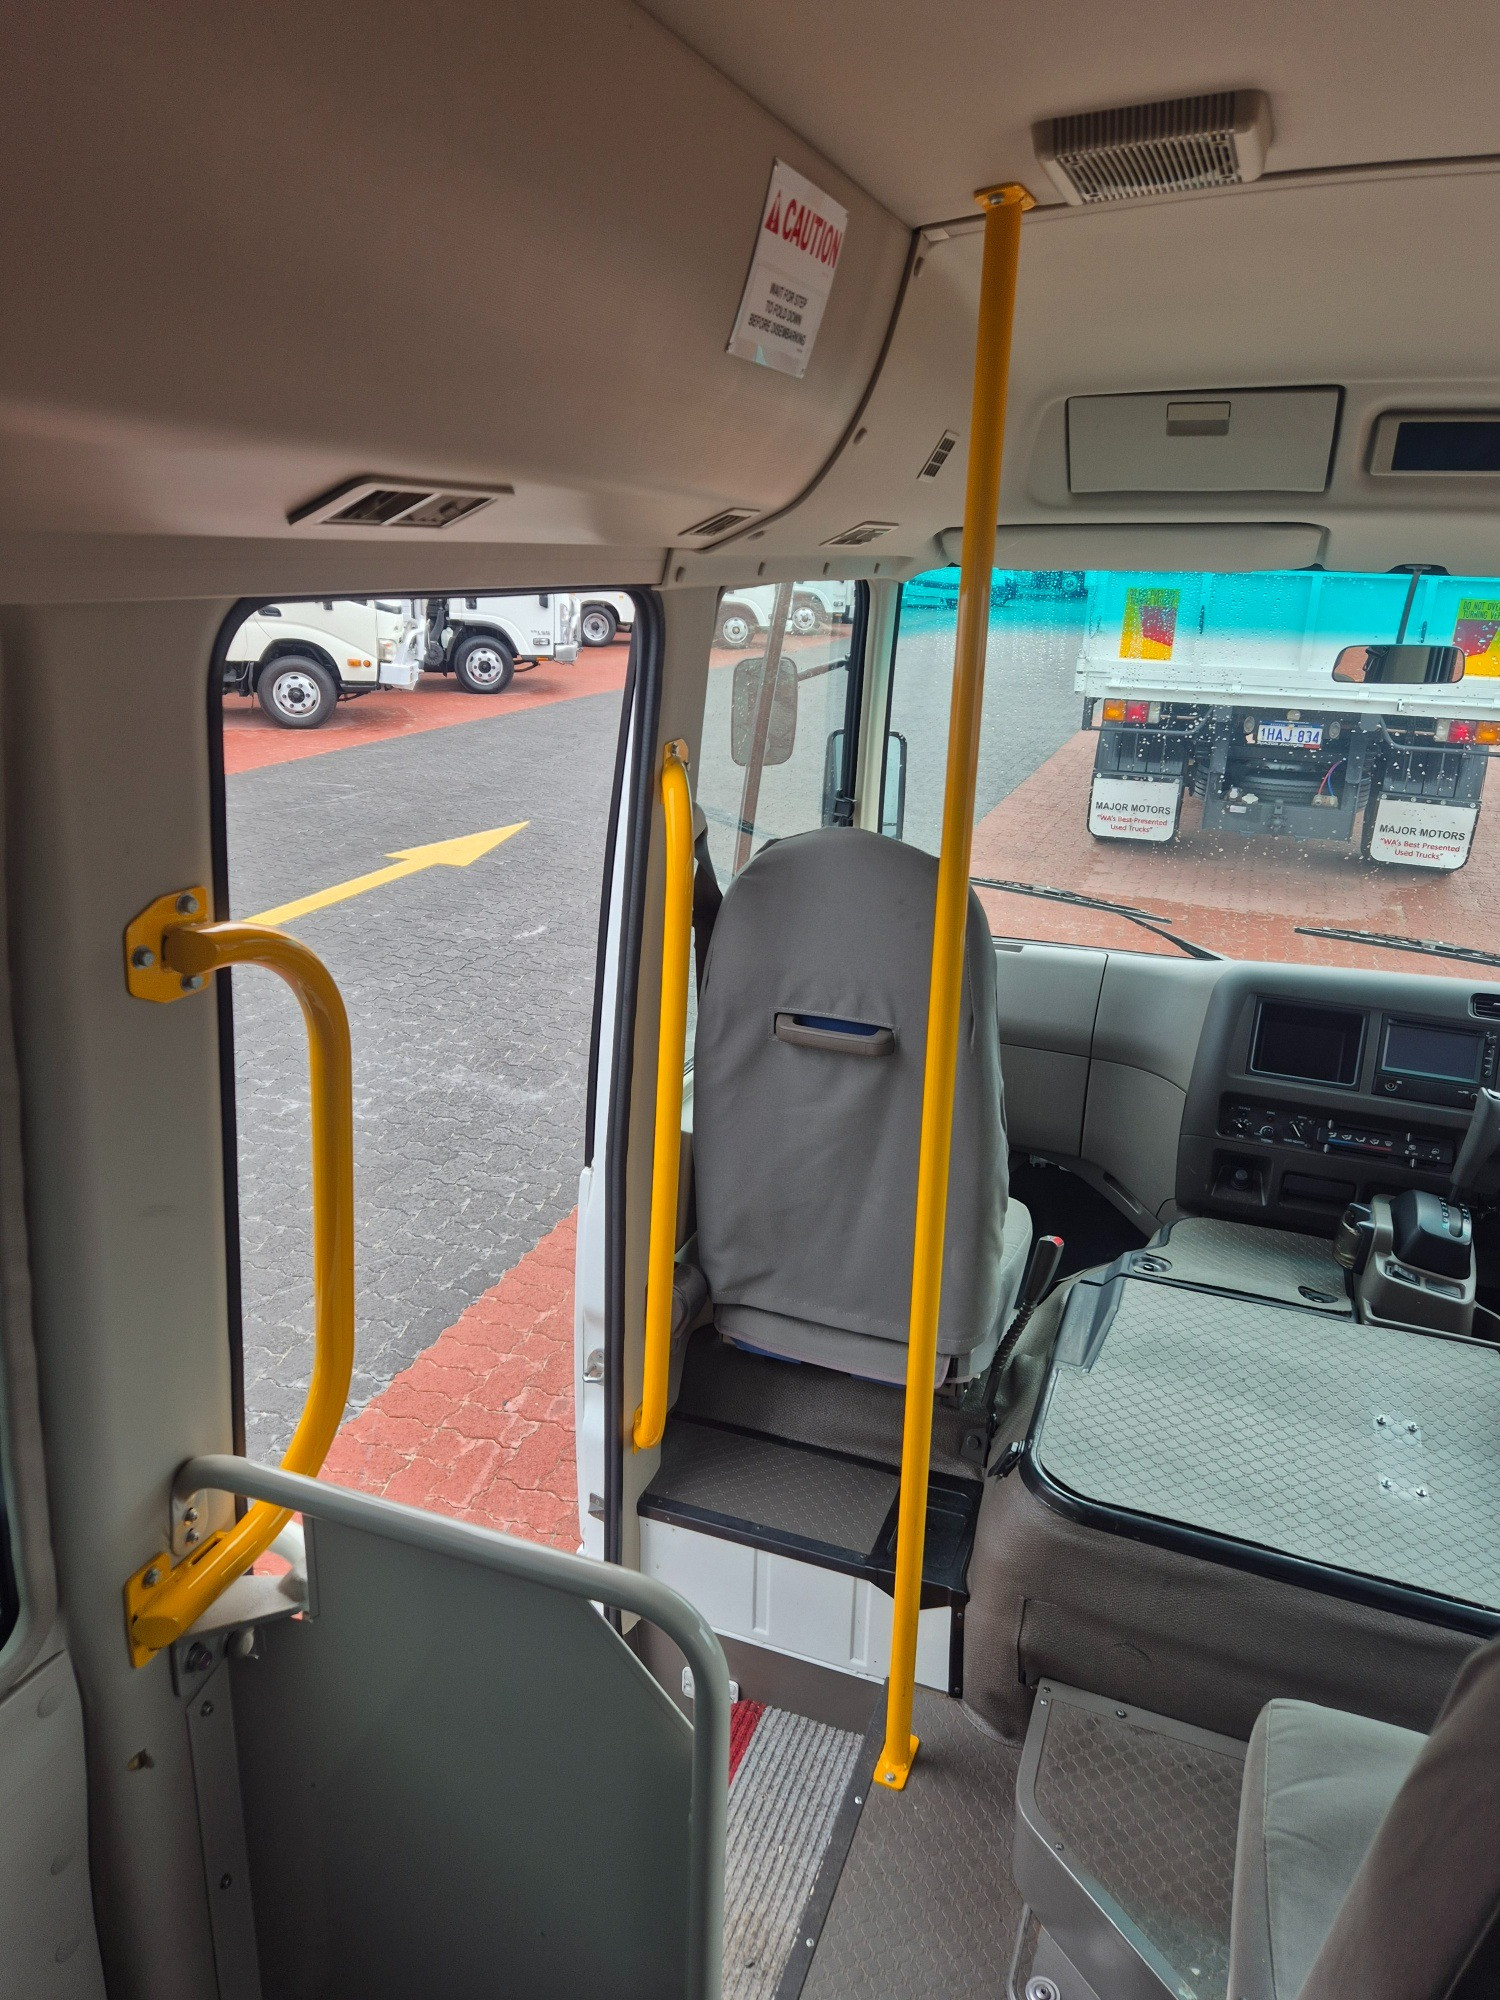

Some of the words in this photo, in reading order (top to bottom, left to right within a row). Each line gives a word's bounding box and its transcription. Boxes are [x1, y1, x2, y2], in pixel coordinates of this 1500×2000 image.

[782, 198, 842, 269] CAUTION
[783, 289, 795, 303] FOR
[793, 294, 807, 308] STEP
[765, 299, 774, 314] TO
[773, 303, 788, 319] FOLD
[748, 313, 771, 332] BEFORE
[1096, 801, 1129, 811] MAJOR
[1131, 804, 1171, 815] MOTORS
[1133, 818, 1168, 826] Presented
[1379, 824, 1417, 836] MAJOR
[1419, 828, 1466, 841] MOTORS
[1394, 849, 1413, 857] Used
[1403, 840, 1420, 848] Best
[1422, 842, 1461, 852] Presented
